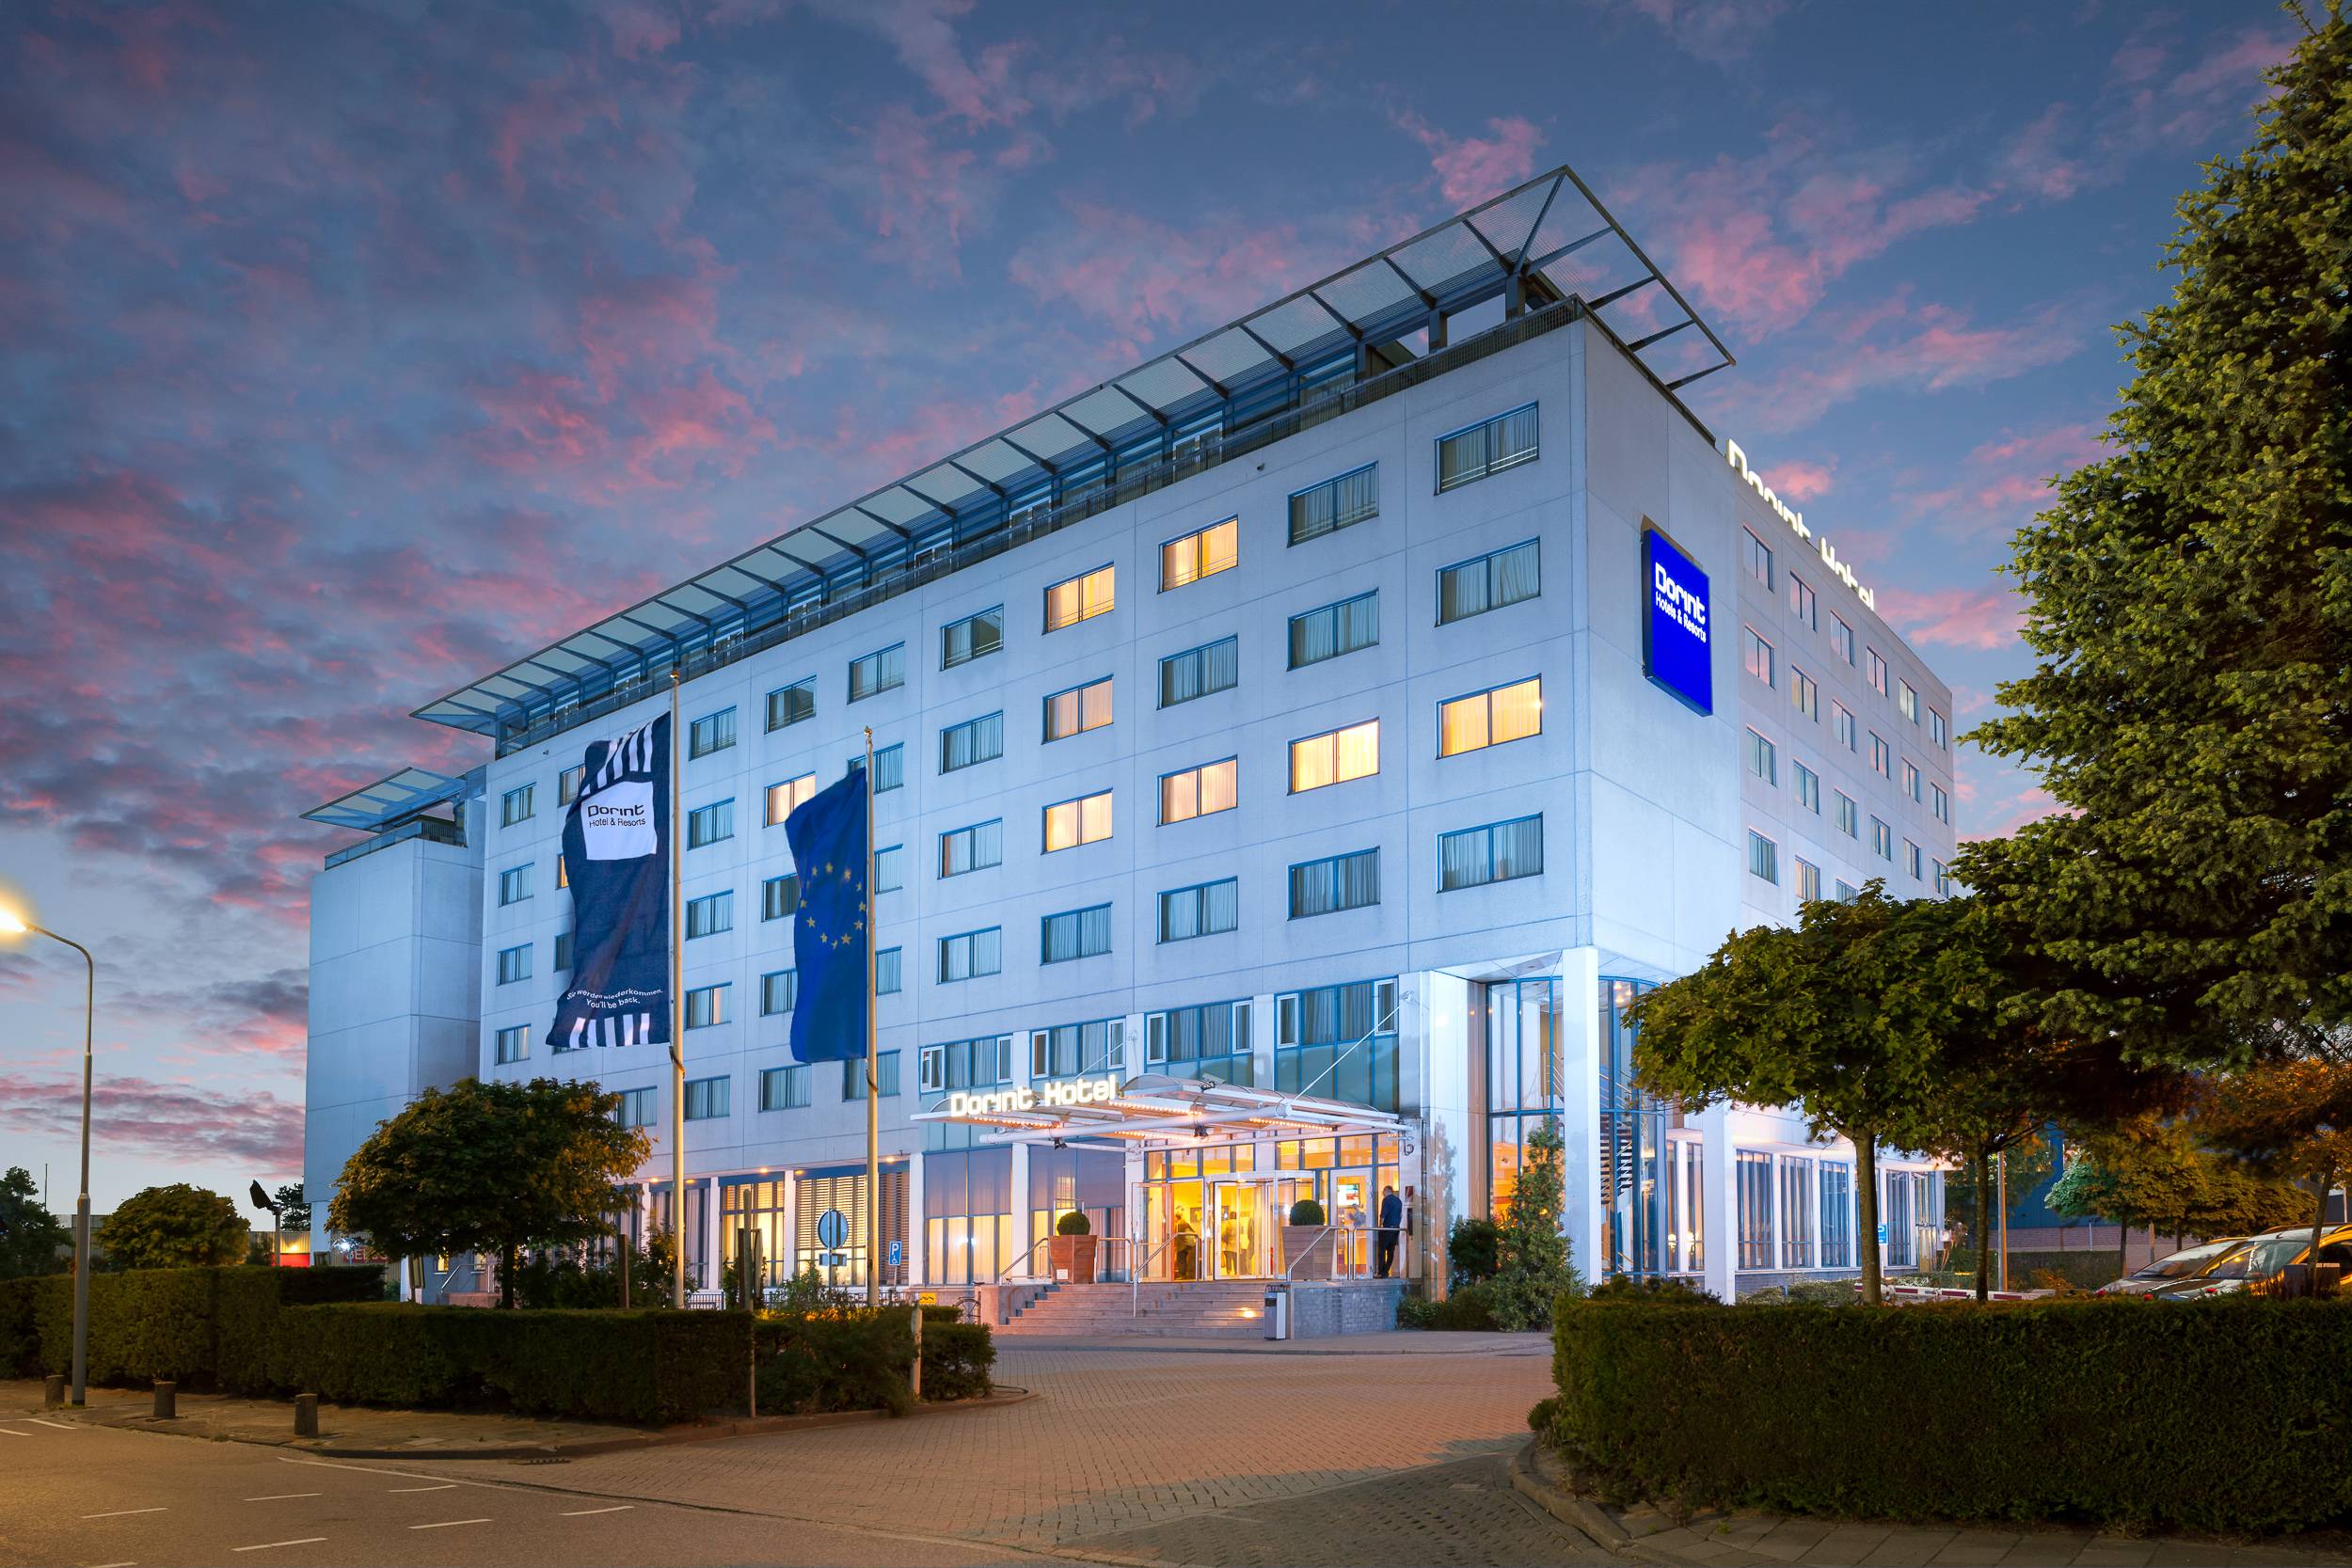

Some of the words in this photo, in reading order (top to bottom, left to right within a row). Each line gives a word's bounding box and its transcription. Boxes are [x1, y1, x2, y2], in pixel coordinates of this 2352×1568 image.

[1655, 562, 1706, 625] Dorint
[1655, 591, 1677, 620] Hotels
[1677, 609, 1683, 626] &
[1683, 612, 1707, 643] Resorts
[588, 804, 644, 817] Dorint
[590, 818, 609, 828] Hotel
[618, 818, 646, 827] Resorts
[586, 999, 606, 1008] You'll
[608, 1001, 617, 1009] be
[618, 997, 641, 1006] back.
[950, 1086, 1033, 1117] Dorint
[1044, 1074, 1117, 1107] Hotel
[891, 1243, 899, 1256] P
